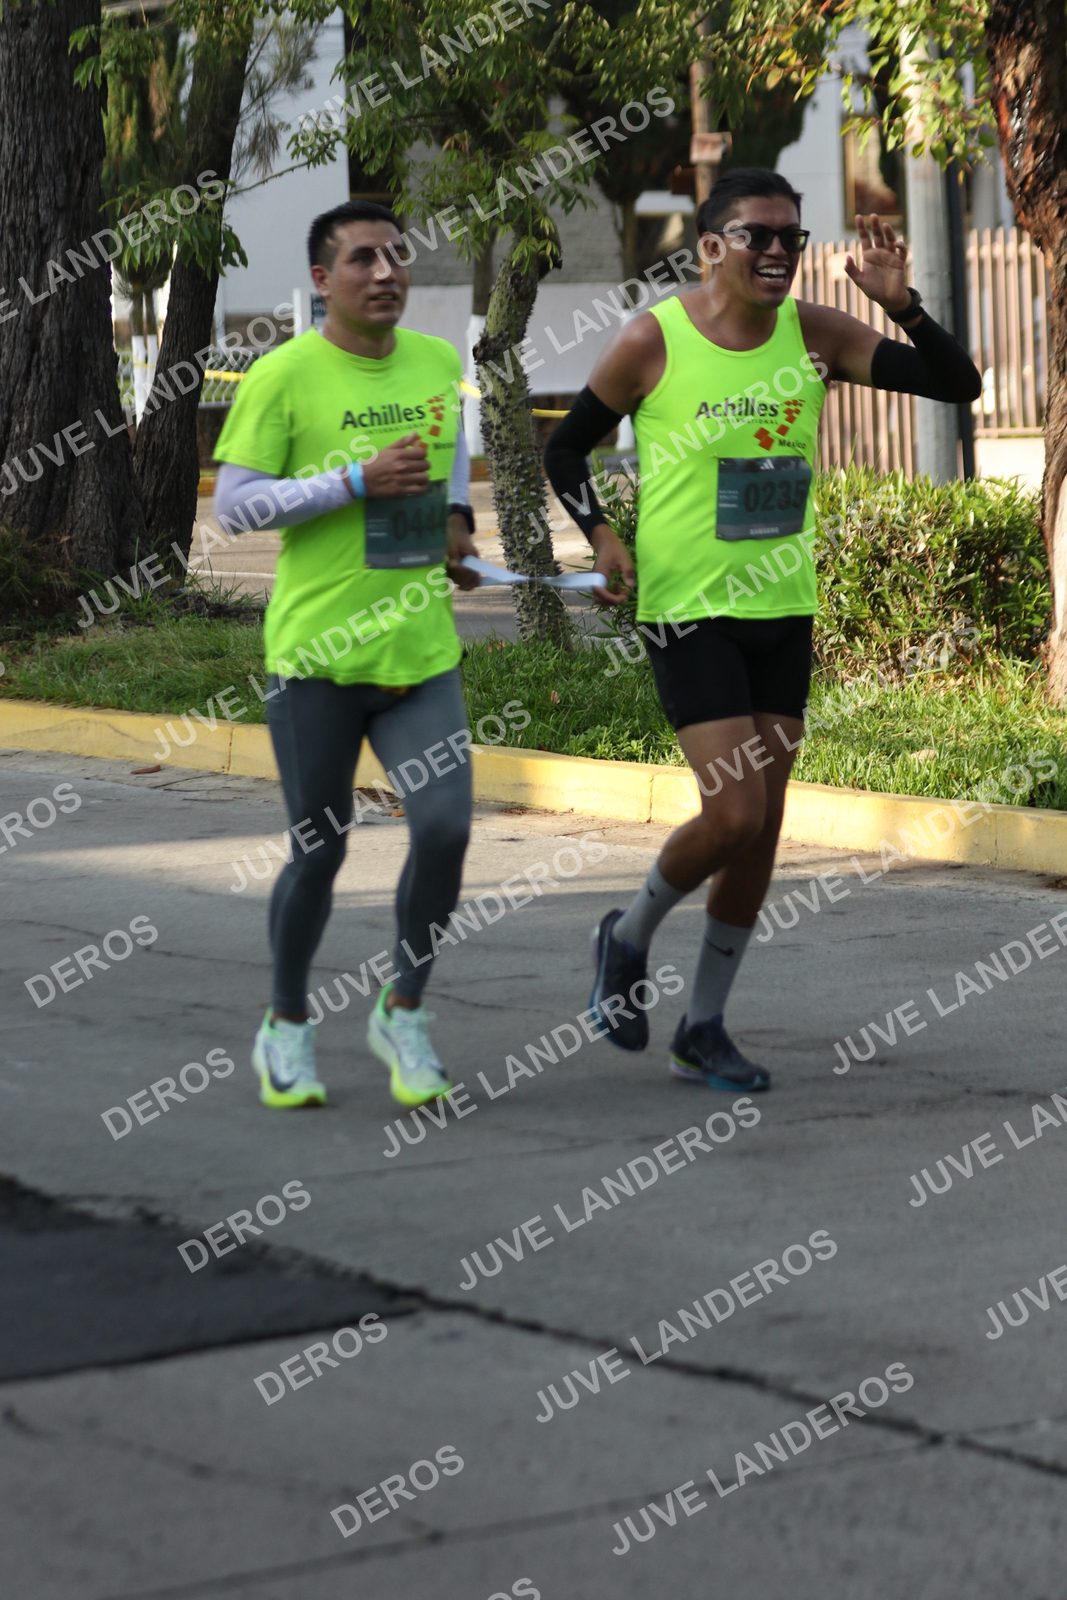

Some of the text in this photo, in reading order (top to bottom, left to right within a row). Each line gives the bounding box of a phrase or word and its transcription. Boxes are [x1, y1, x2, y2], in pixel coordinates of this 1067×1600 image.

[341, 402, 426, 430] Achilles
[695, 397, 780, 419] Achilles
[743, 480, 809, 513] 0235
